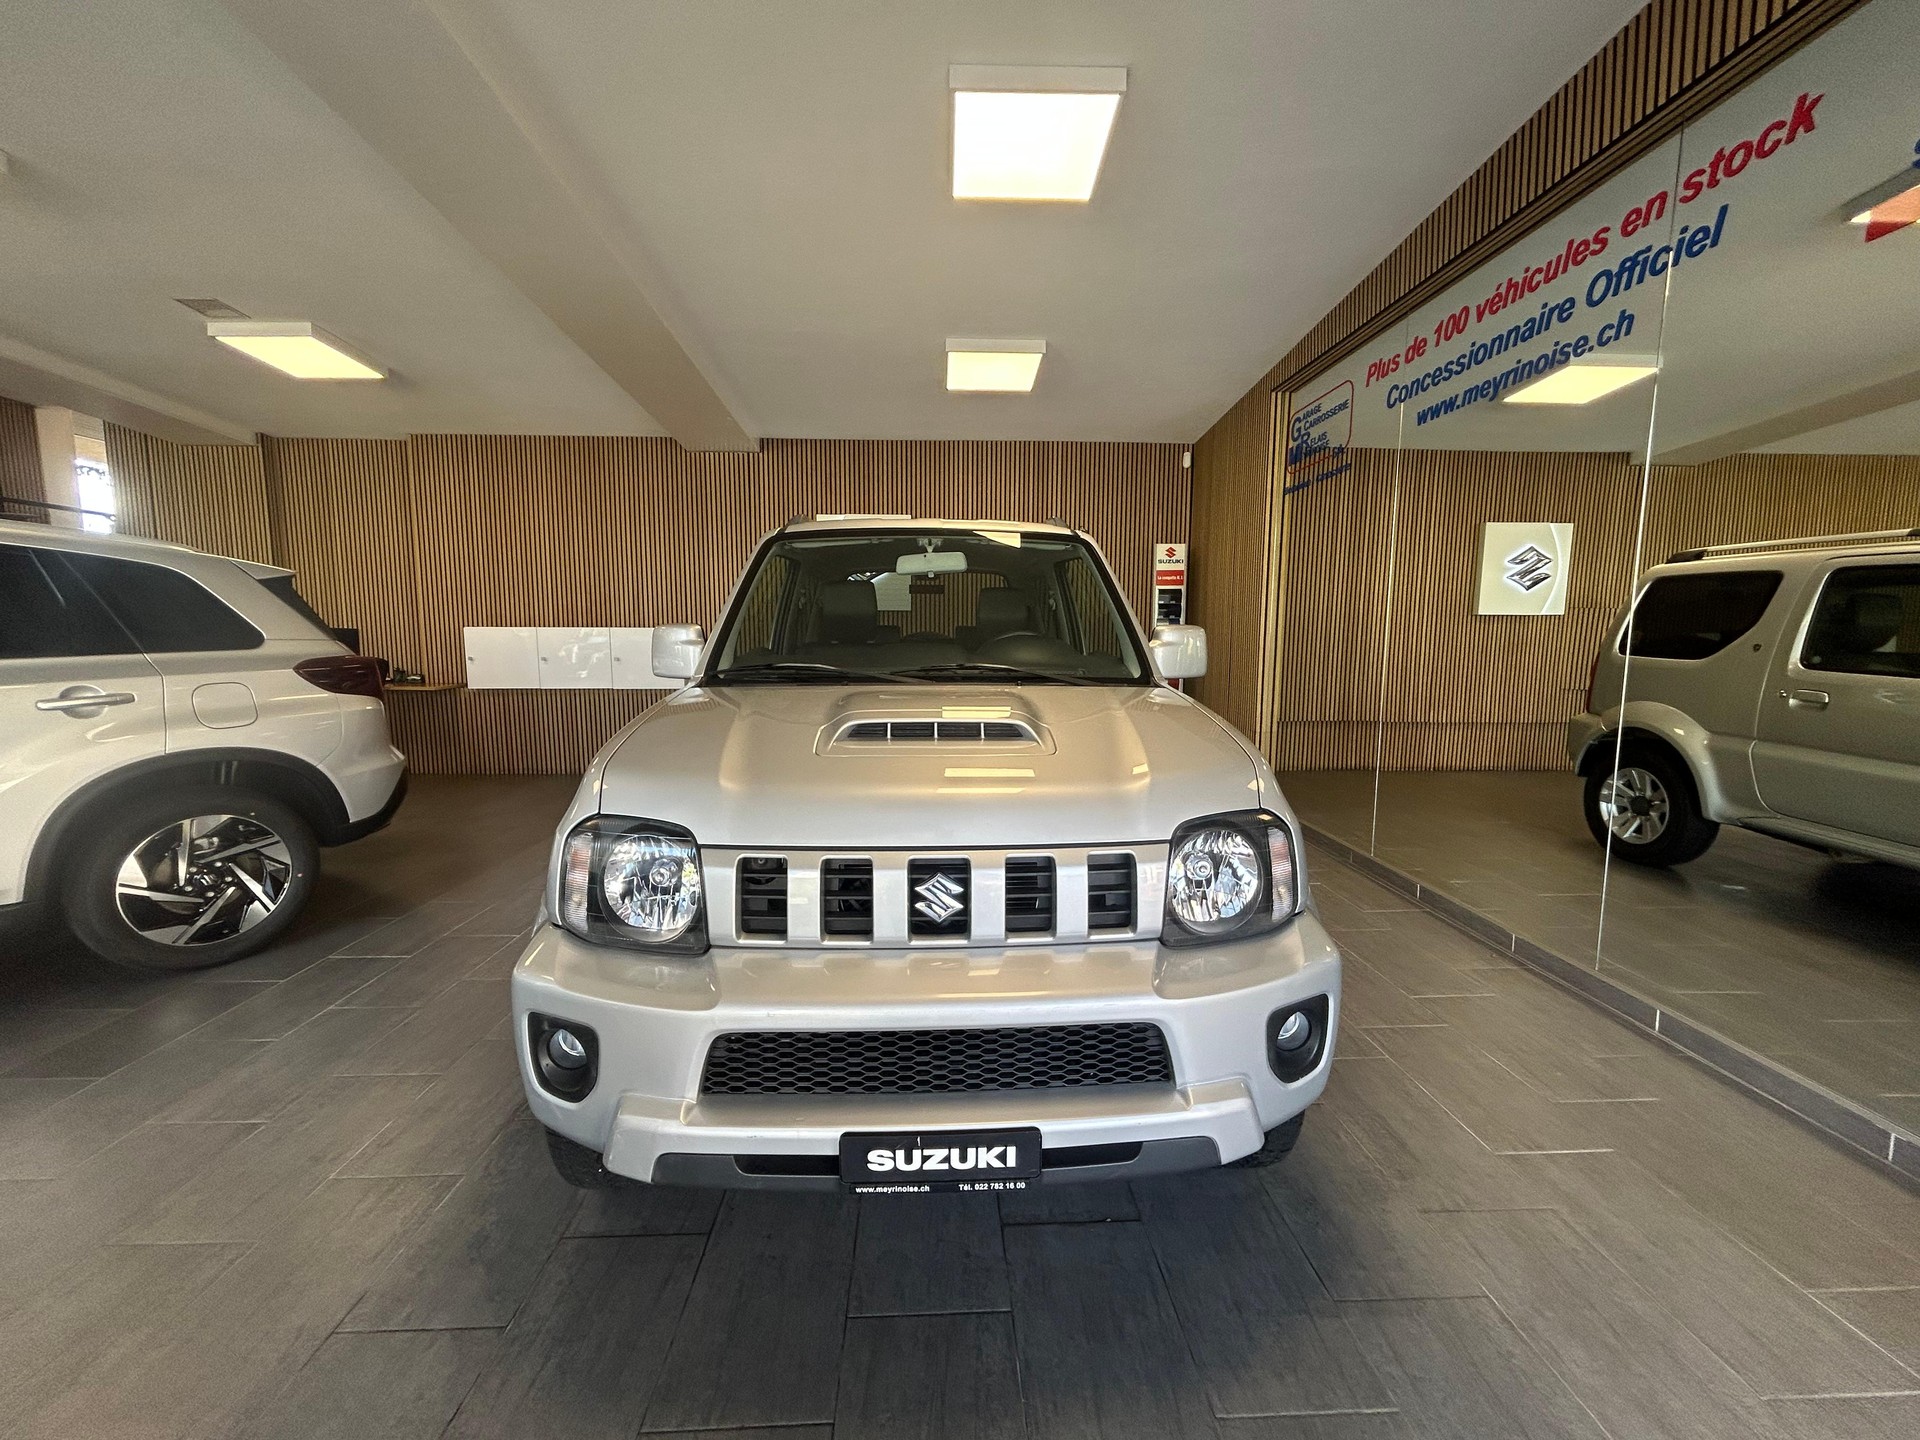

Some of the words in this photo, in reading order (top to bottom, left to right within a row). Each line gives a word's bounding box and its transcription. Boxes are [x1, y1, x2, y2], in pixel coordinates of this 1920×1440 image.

[1365, 353, 1401, 388] Plus
[1404, 335, 1429, 365] de
[1434, 305, 1470, 349] 100
[1476, 226, 1611, 323] véhicules
[1620, 190, 1668, 238] en
[1679, 92, 1826, 203] stock
[1387, 296, 1576, 410] Concessionnaire
[1586, 203, 1729, 308] Officiel
[1416, 308, 1636, 426] www.meyrinoise.ch
[1303, 398, 1350, 431] CARROSSERIE
[855, 1185, 930, 1194] www.meyrinoise.ch
[958, 1183, 973, 1191] Tél.
[974, 1183, 989, 1191] 022
[990, 1182, 1004, 1190] 782
[1016, 1181, 1026, 1189] 00
[867, 1146, 1017, 1172] SUZUKI
